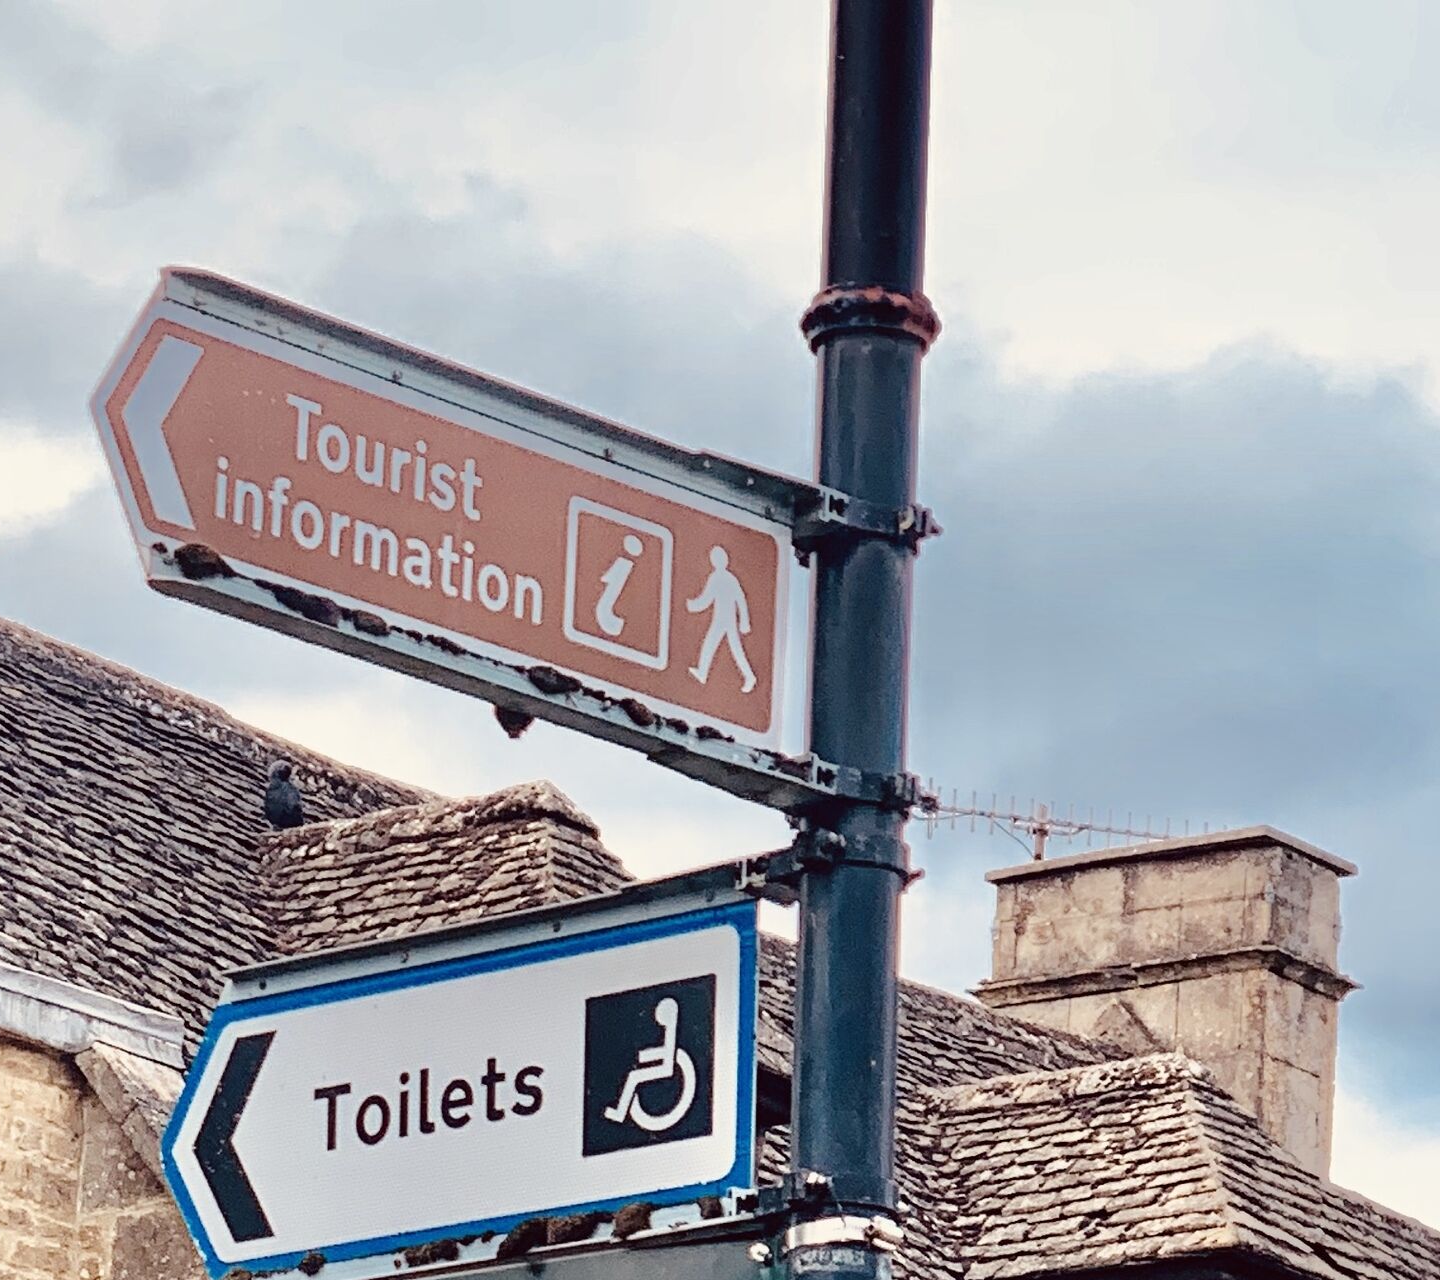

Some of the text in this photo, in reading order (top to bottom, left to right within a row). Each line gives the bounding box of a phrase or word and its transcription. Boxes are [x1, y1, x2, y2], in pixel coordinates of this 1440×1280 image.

[286, 393, 483, 522] Tourist
[213, 455, 545, 626] information
[314, 1056, 545, 1151] Toilets
